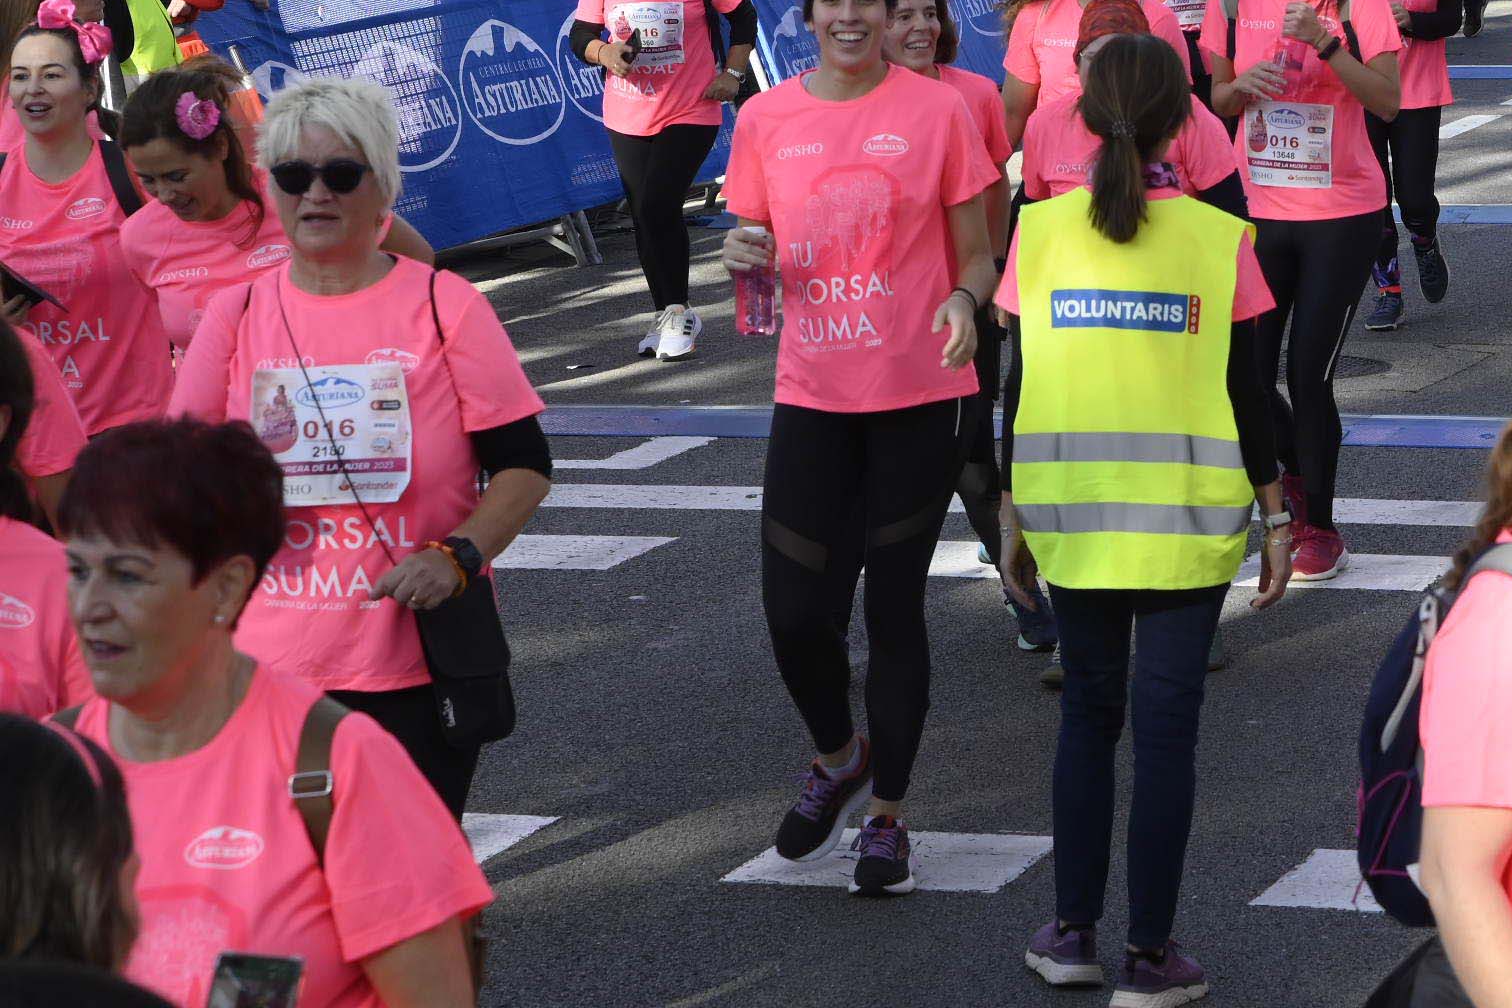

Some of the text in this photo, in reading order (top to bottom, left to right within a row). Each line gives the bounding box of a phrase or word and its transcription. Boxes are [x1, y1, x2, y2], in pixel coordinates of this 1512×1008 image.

[1240, 18, 1275, 30] OYSHO
[479, 62, 513, 78] CENTRAL
[469, 71, 562, 119] ASTURIANA
[866, 141, 906, 152] ASTURIANA
[1270, 135, 1300, 149] 016
[777, 142, 824, 160] OYSHO
[1272, 151, 1296, 160] 13648
[789, 241, 813, 269] TU
[1053, 298, 1184, 324] VOLUNTARIS
[798, 311, 878, 344] SUMA
[302, 389, 360, 402] ASTURIANA
[303, 418, 356, 439] 016
[311, 463, 325, 472] DE
[373, 461, 395, 470] 2023
[350, 480, 399, 492] Santander
[262, 563, 374, 598] SUMA
